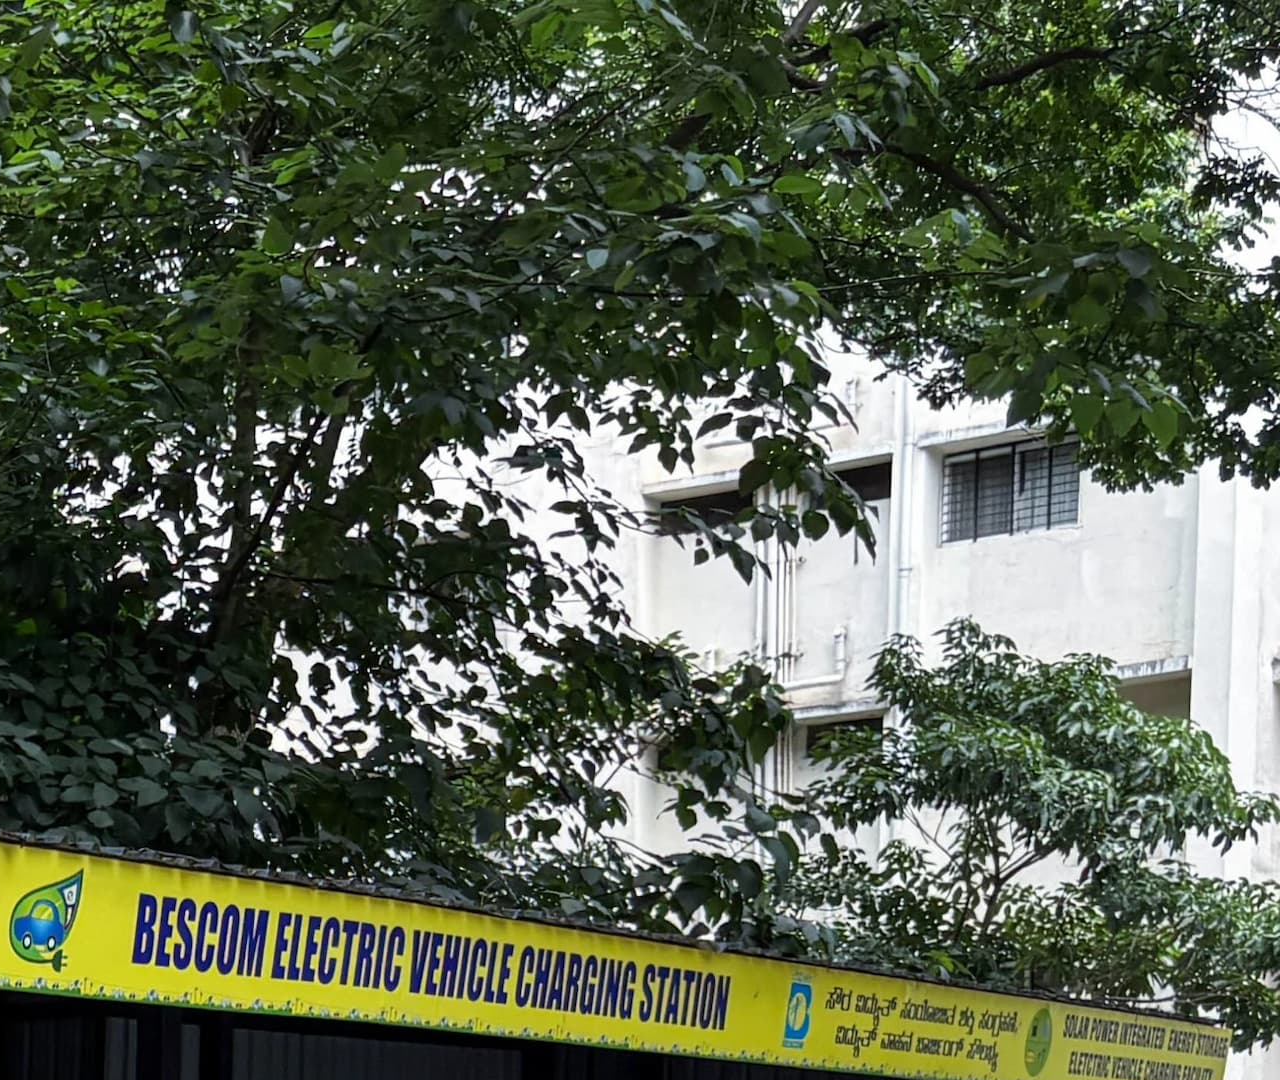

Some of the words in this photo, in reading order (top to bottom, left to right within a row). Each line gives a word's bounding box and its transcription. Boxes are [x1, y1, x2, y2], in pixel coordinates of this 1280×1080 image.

[132, 892, 269, 977] BESCOM
[271, 909, 405, 993] ELECTRIC
[408, 929, 515, 1005] VEHICLE
[515, 944, 637, 1020] CHARGING
[639, 963, 731, 1031] STATION
[1063, 1014, 1090, 1039] SOLAR
[1090, 1018, 1120, 1043] POWER
[1119, 1022, 1166, 1050] INTEGRATED
[1167, 1029, 1197, 1054] ENERGY
[1196, 1034, 1229, 1058] STORAGE
